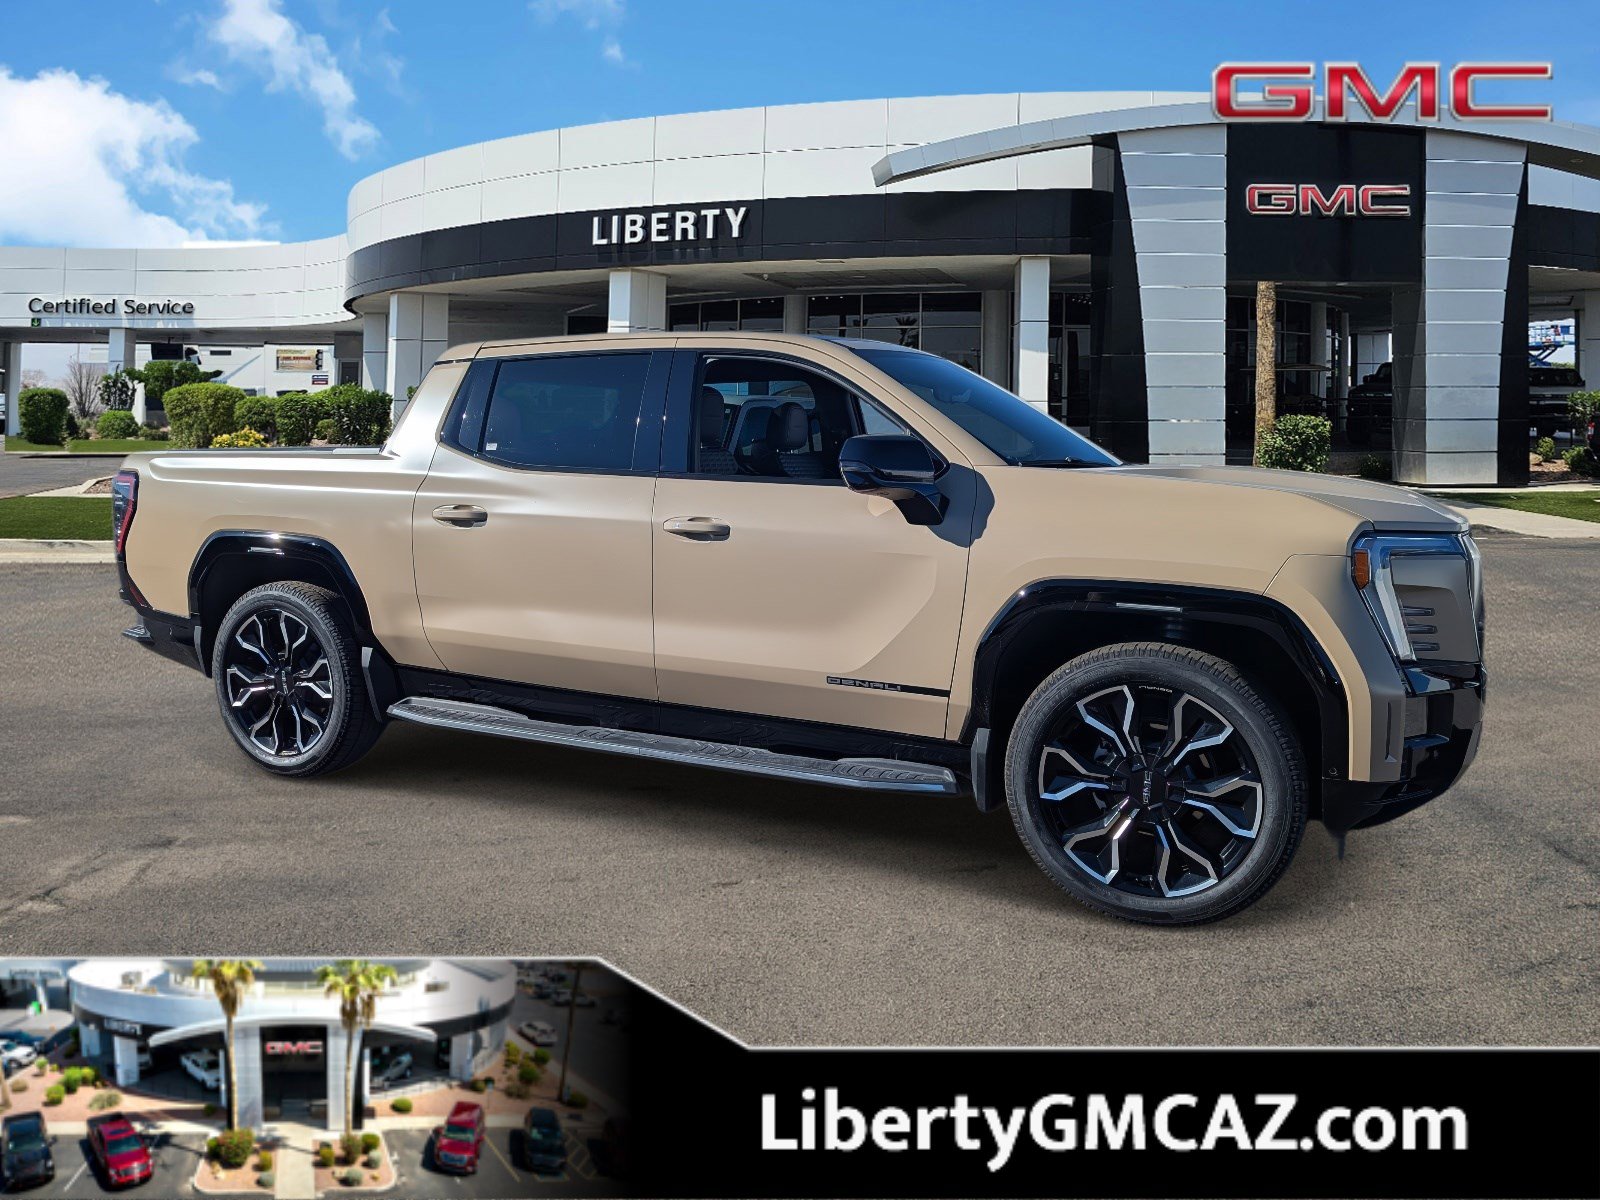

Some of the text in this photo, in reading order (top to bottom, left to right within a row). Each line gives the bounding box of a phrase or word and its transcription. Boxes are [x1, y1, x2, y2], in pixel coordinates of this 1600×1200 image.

[1245, 183, 1412, 217] GMC
[592, 207, 747, 245] LIBERTY
[28, 297, 194, 315] Certified Service
[827, 677, 902, 691] DENALI
